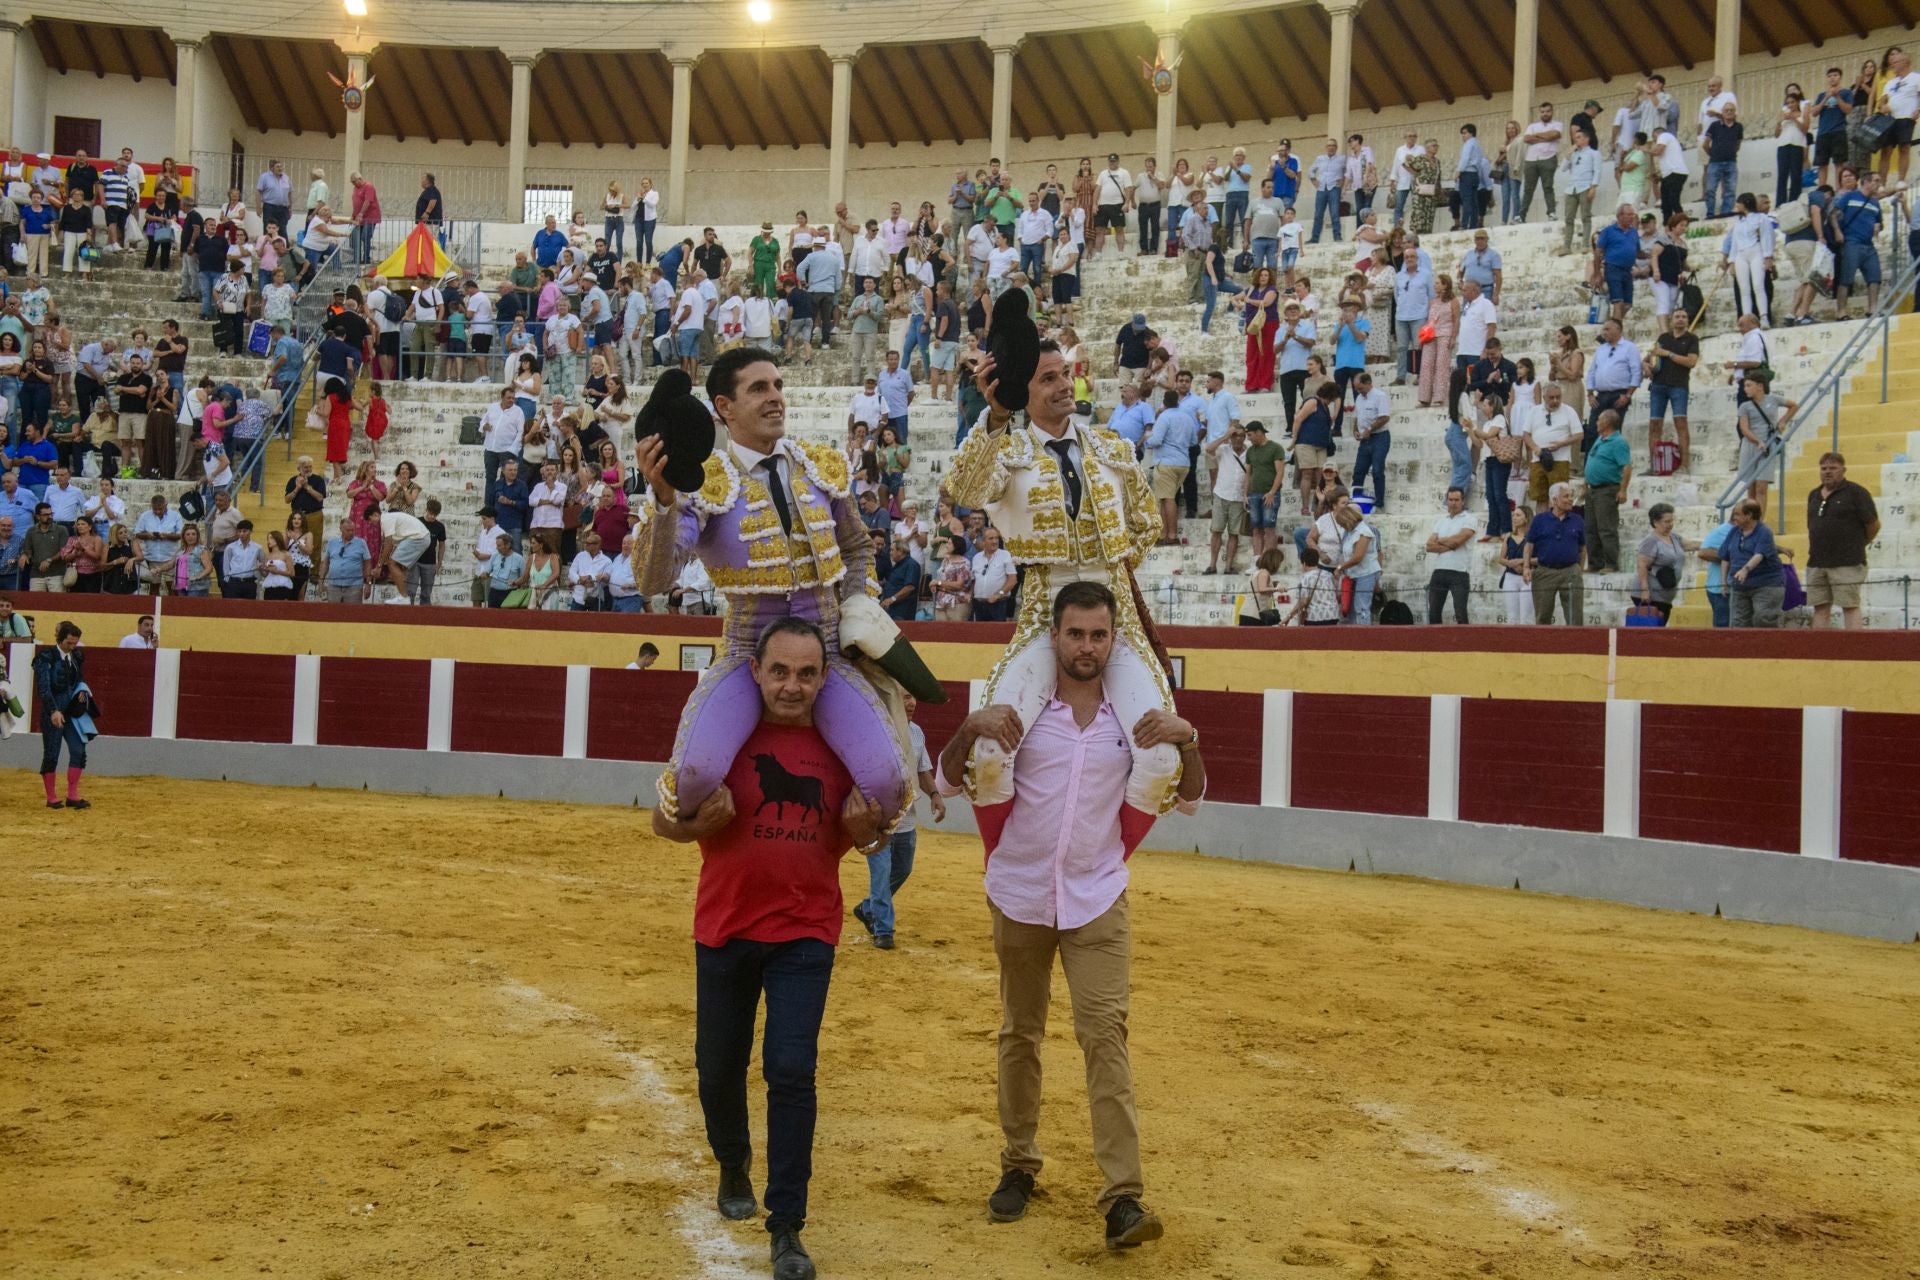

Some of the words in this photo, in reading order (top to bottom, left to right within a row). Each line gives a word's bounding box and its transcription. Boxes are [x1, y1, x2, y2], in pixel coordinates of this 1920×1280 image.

[1406, 441, 1418, 449] 70
[1438, 465, 1450, 473] 70
[1890, 506, 1904, 514] 76
[1415, 553, 1427, 561] 67
[1209, 611, 1220, 619] 61
[1588, 615, 1601, 624] 70
[753, 825, 818, 843] ESPAÑA
